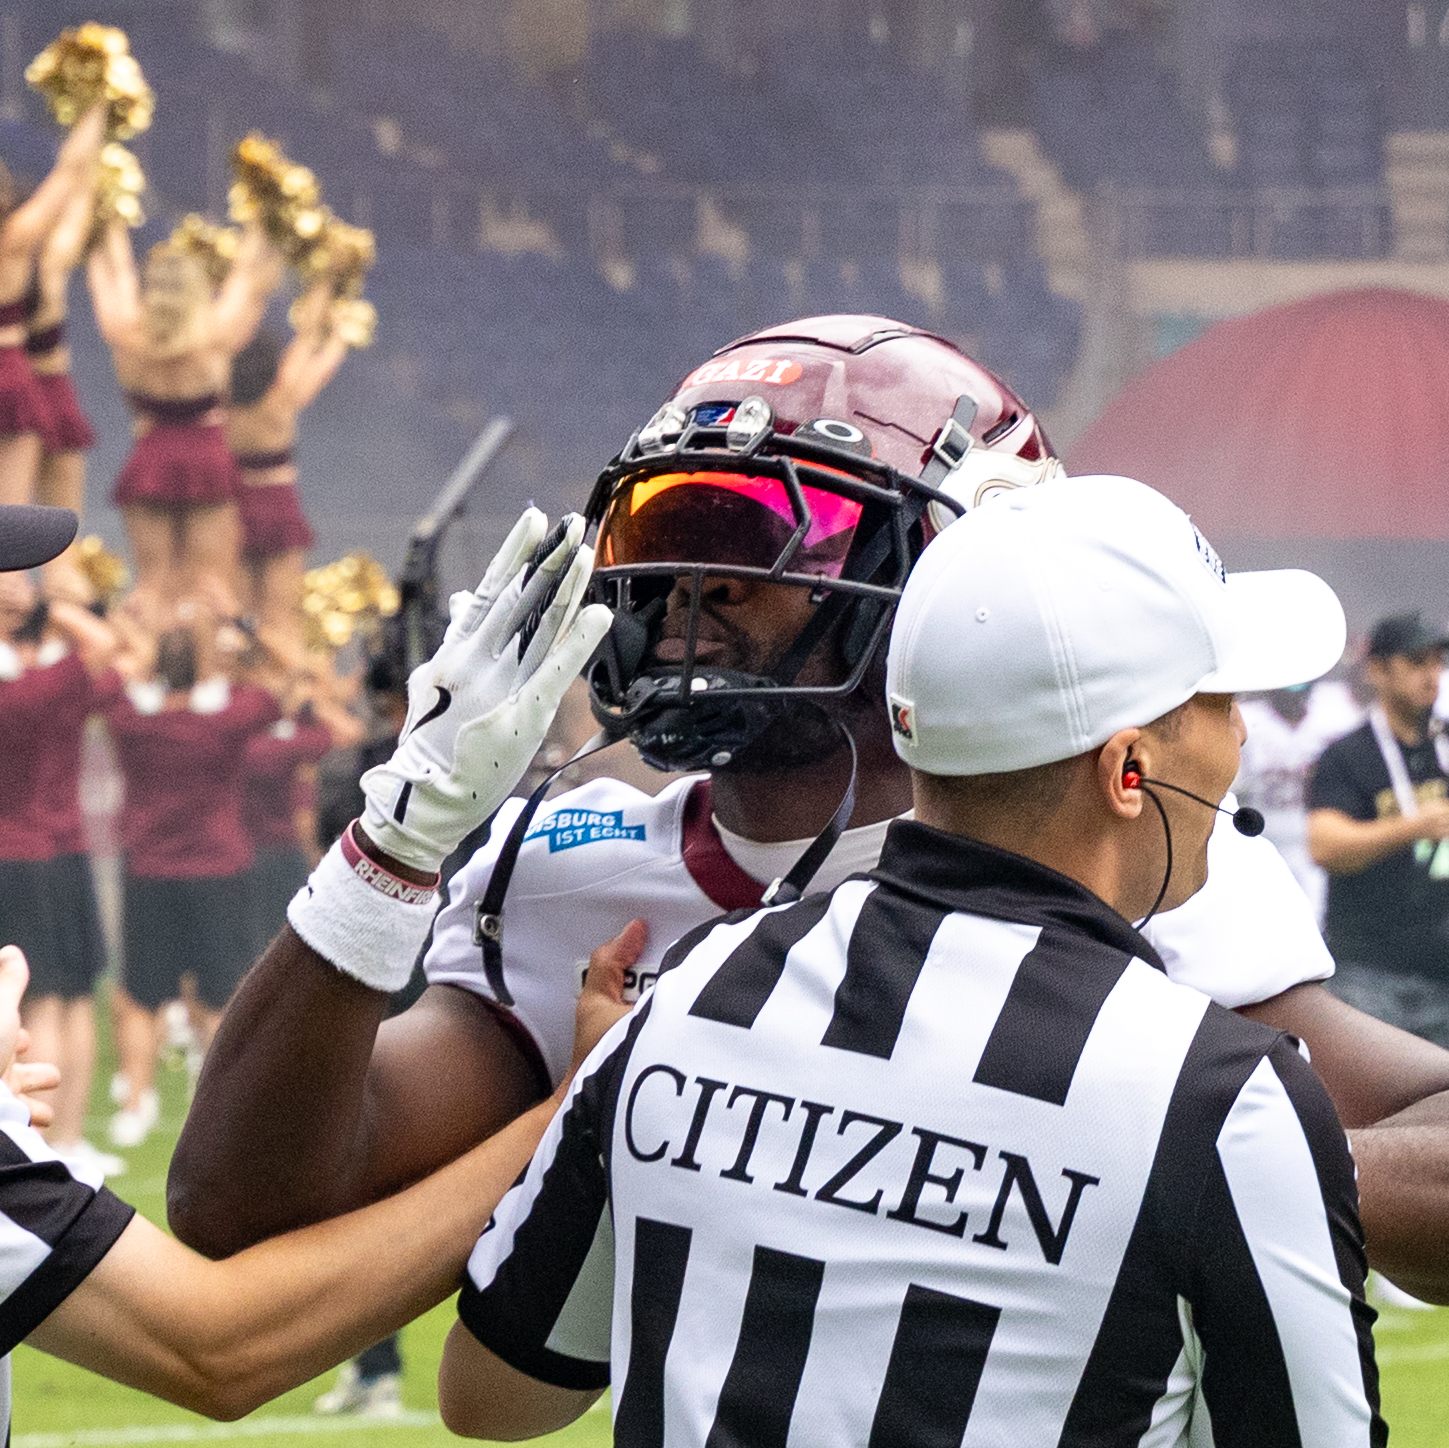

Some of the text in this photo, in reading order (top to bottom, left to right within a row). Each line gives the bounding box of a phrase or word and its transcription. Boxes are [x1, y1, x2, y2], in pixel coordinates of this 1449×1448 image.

[693, 359, 792, 385] GAZI
[556, 826, 638, 846] IST ECHT
[354, 859, 434, 905] RHEINFIR
[624, 1063, 1101, 1266] CITIZEN
